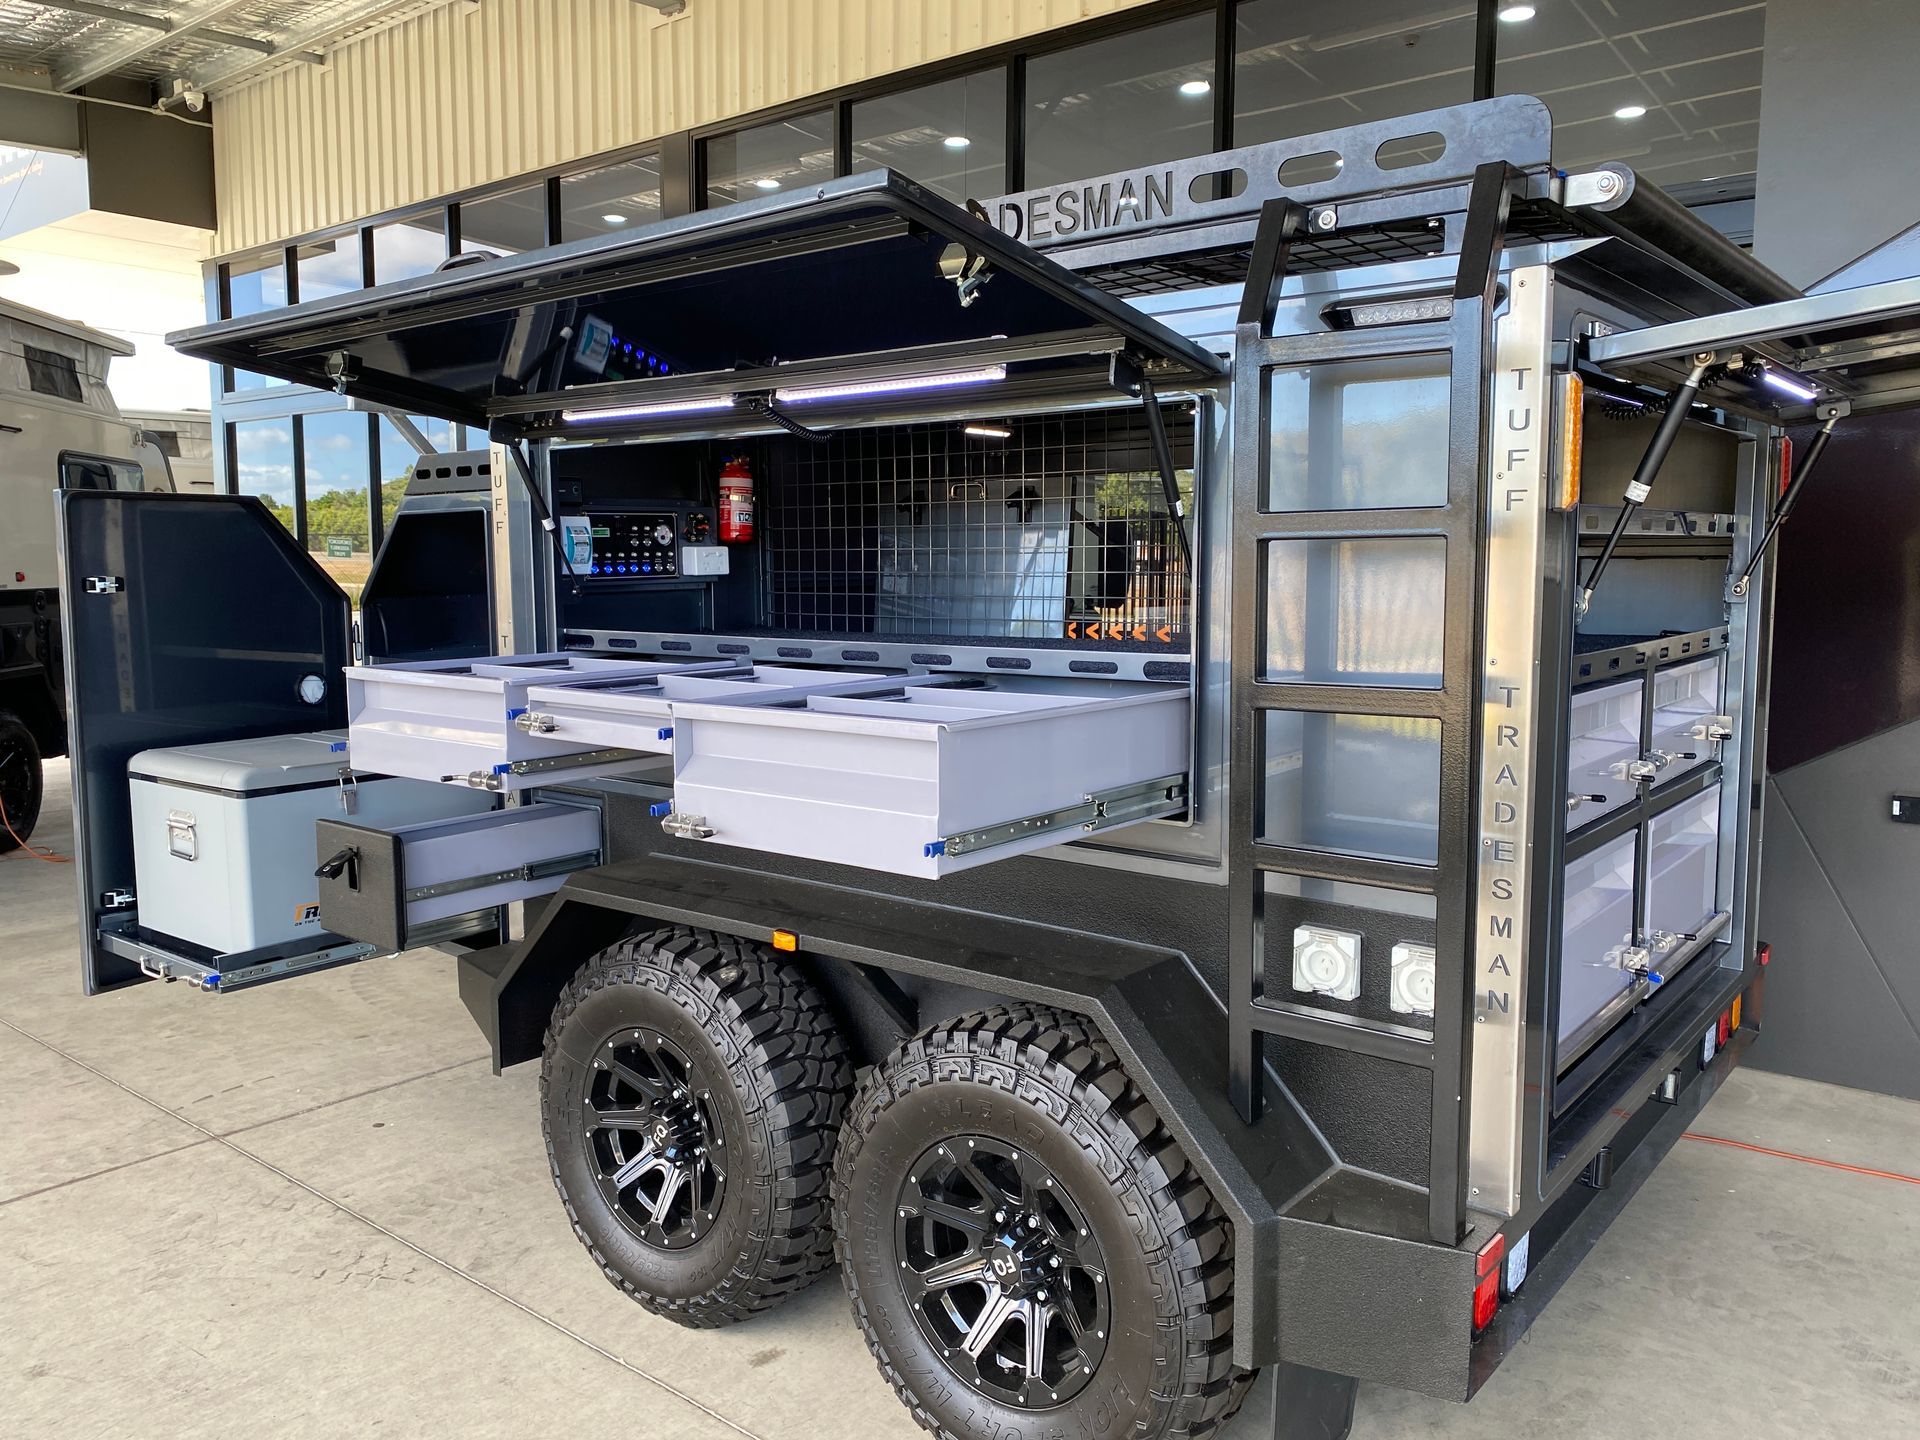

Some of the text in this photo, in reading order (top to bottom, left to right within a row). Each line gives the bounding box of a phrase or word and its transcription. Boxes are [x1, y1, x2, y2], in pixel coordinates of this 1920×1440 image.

[999, 171, 1173, 241] DESMAN
[1505, 367, 1532, 512] TUFF
[492, 451, 504, 535] TUFF
[1487, 686, 1520, 1014] TRADESMAN
[653, 1124, 668, 1147] FQ
